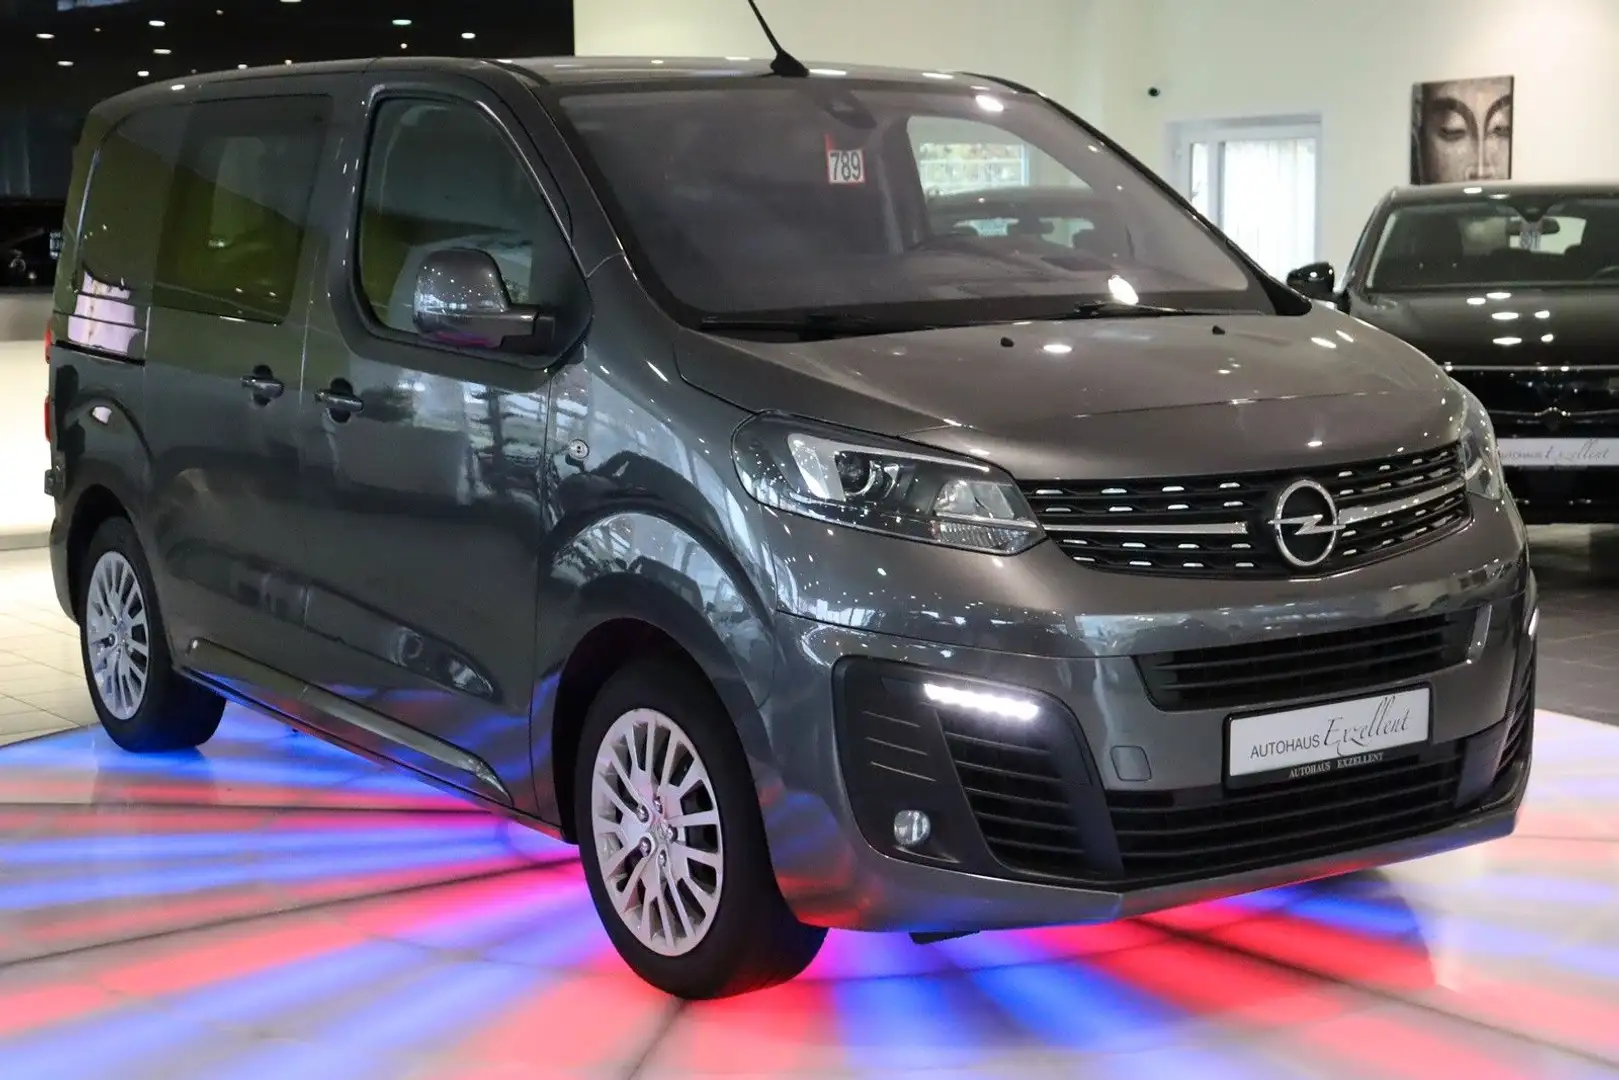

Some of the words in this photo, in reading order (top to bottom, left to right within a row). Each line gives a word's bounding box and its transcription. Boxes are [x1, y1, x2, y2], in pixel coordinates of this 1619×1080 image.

[830, 151, 861, 181] 789
[1250, 734, 1320, 759] AUTOHAUS
[1323, 695, 1410, 757] Exzellent
[1288, 761, 1331, 778] AUTOHAUS
[1337, 752, 1384, 769] EXZELLENT
